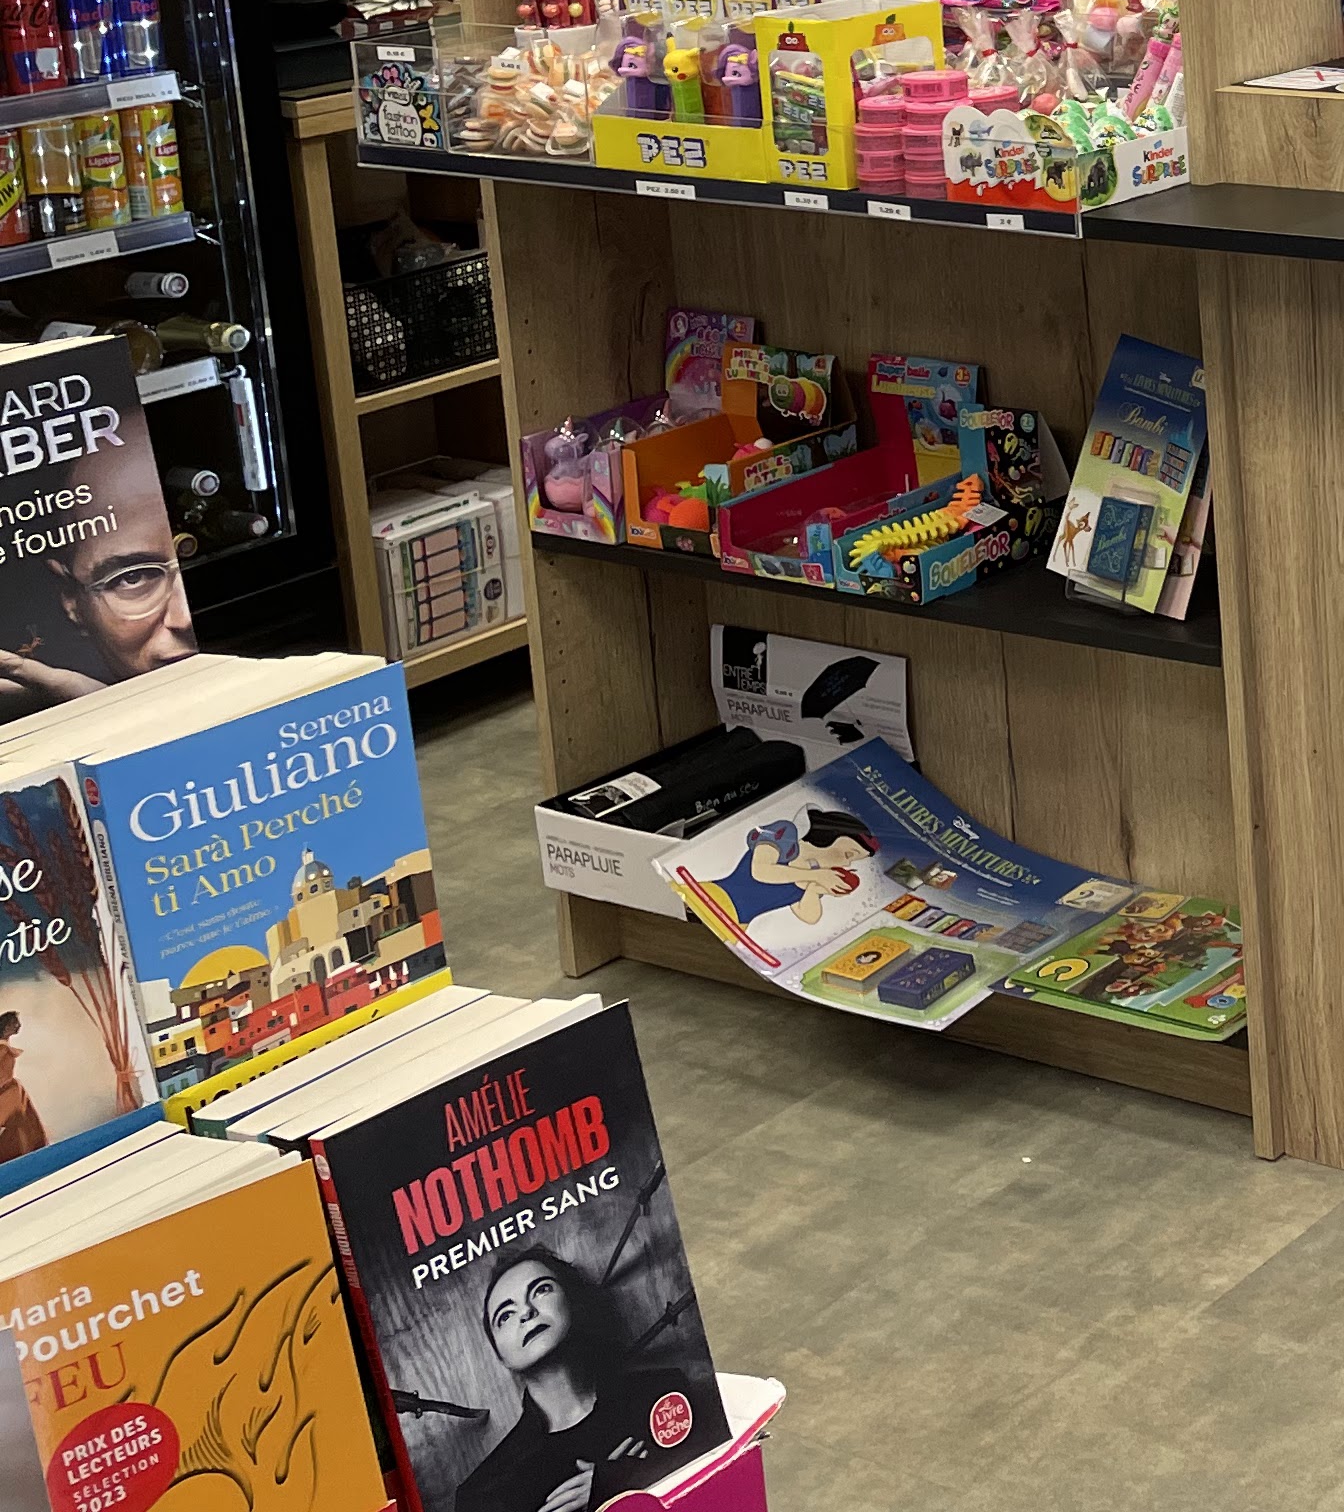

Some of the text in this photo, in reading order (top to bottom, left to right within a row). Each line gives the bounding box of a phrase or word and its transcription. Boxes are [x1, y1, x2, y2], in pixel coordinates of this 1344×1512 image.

[87, 154, 120, 168] Lipton
[636, 133, 707, 169] PEZ
[778, 159, 827, 182] PEZ
[994, 144, 1025, 160] Kinder
[0, 405, 126, 479] BER
[11, 505, 118, 558] fourmi
[278, 695, 392, 749] Serena
[726, 697, 794, 724] PARAPLUIE
[129, 723, 397, 843] Giuliano
[144, 779, 363, 886] Sarà Perché
[152, 855, 276, 917] ti Amo
[549, 863, 576, 879] MOTS
[441, 1066, 536, 1154] AMÉLIE
[392, 1094, 611, 1254] NOTHOMB
[411, 1166, 621, 1289] PREMIER SANG
[656, 1403, 683, 1417] Livre
[658, 1417, 690, 1442] Poche
[62, 1415, 148, 1467] PRIX DES
[67, 1428, 163, 1486] LECTEURS
[73, 1453, 160, 1503] SÉLECTION
[76, 1485, 127, 1512] 2023
